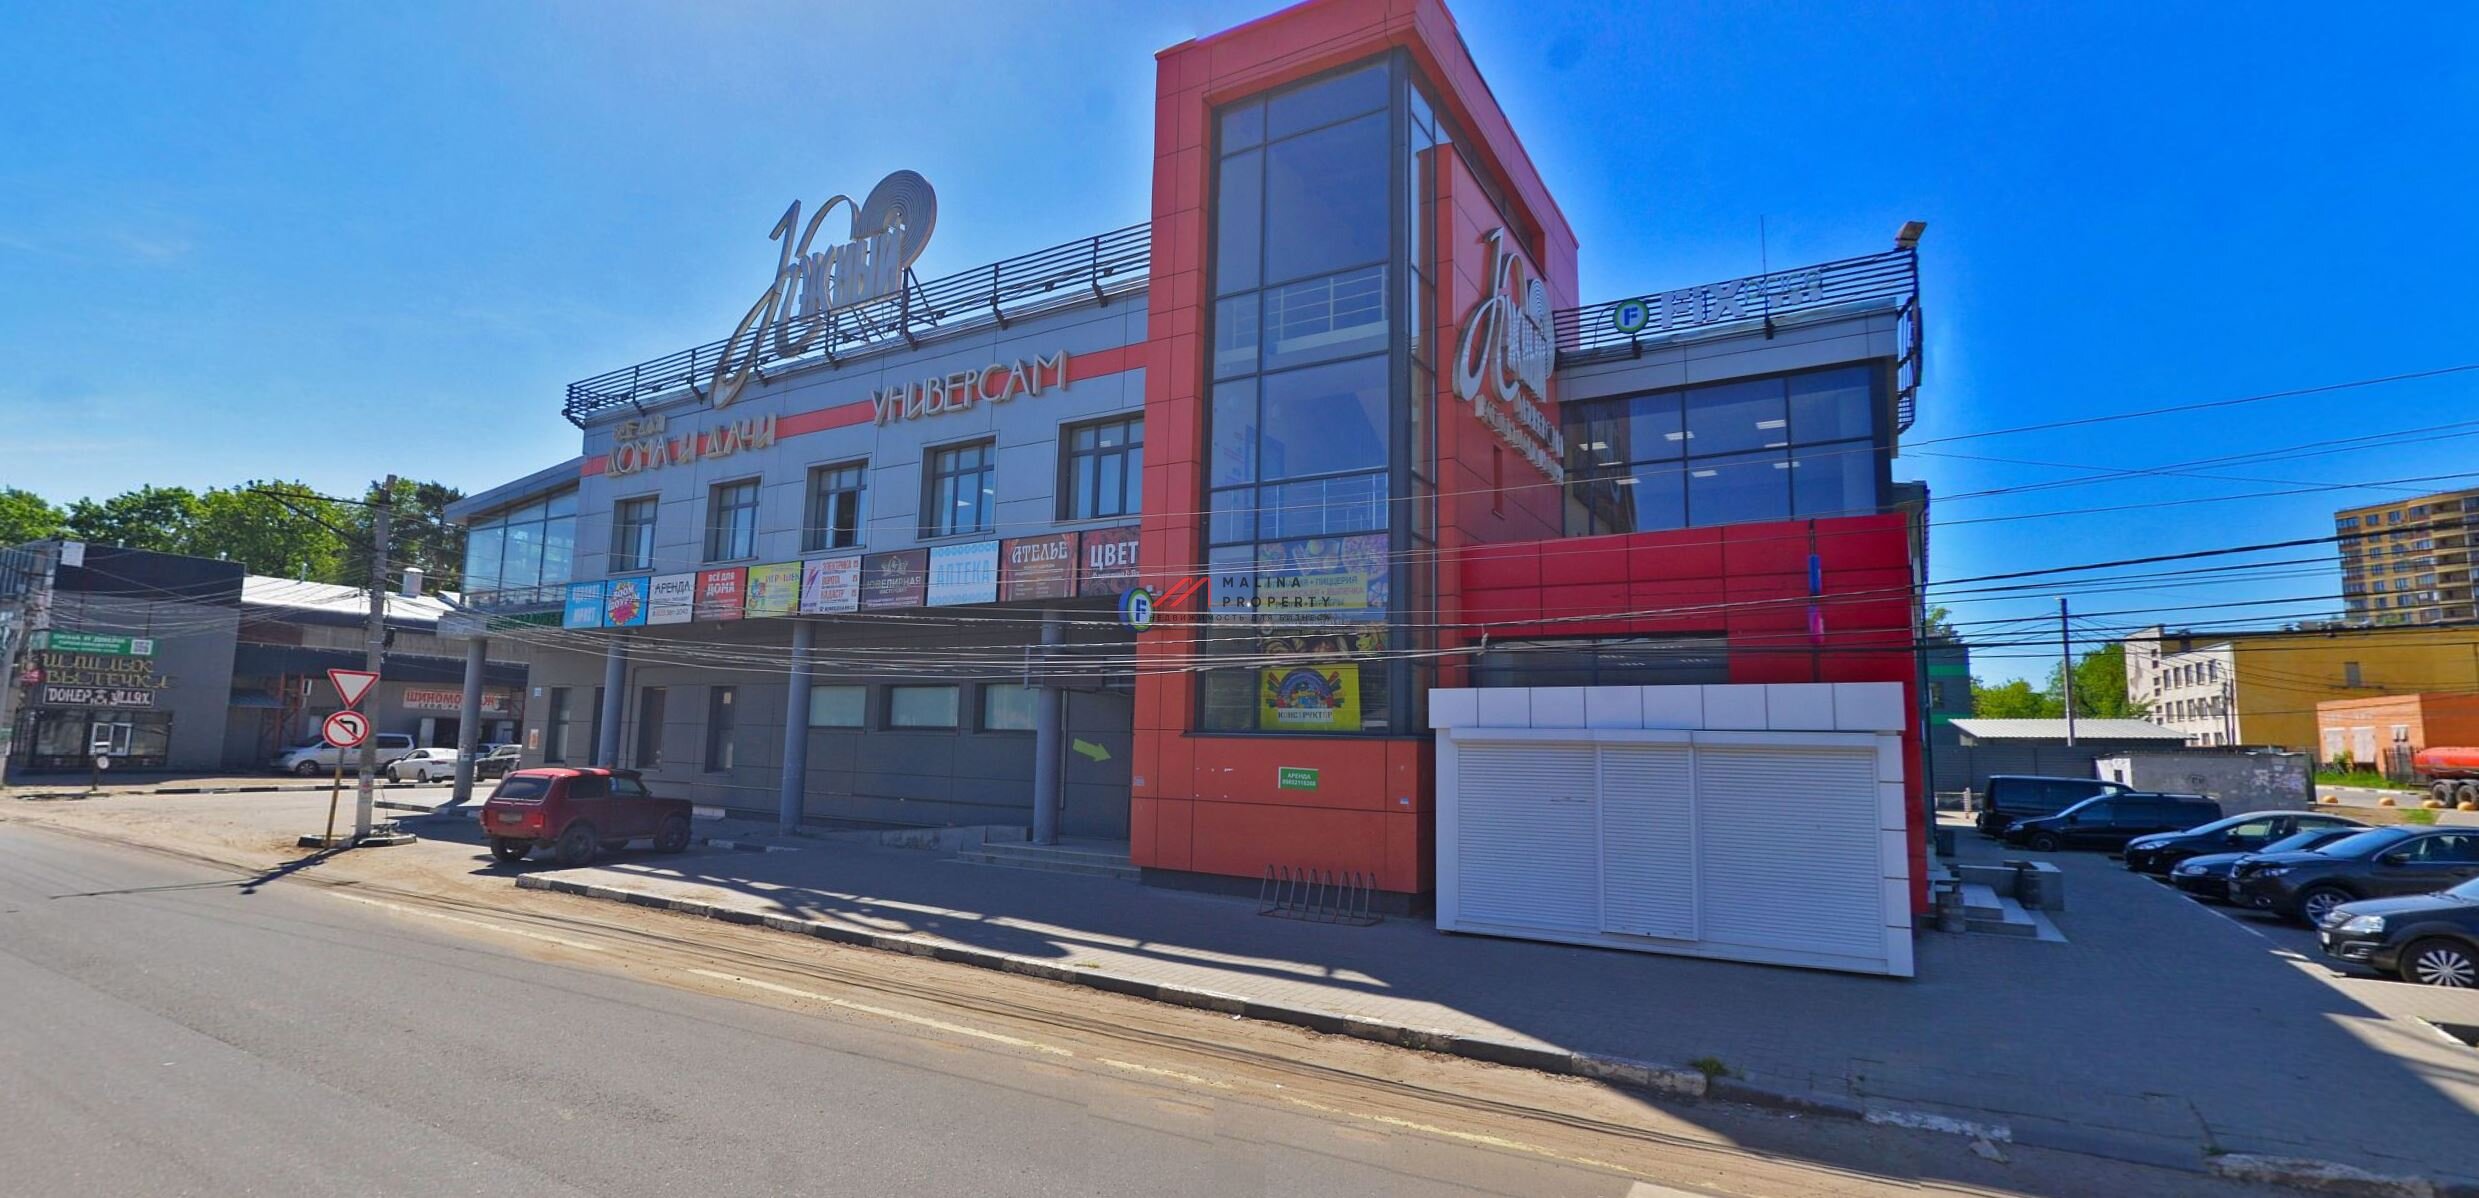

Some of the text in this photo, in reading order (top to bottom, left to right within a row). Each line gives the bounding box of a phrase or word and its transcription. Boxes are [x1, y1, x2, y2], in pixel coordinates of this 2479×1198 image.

[871, 349, 1068, 427] УНИВЕРСАМ
[605, 435, 672, 477] ДОМА
[705, 412, 777, 459] ДАЧИ
[1011, 541, 1068, 564] АТЕЛЬЕ
[1090, 541, 1139, 570] ЦВЕТ
[936, 560, 990, 586] АПТЕКА
[654, 580, 691, 595] АРЕНДА
[706, 581, 735, 596] ДОМА
[48, 687, 93, 703] ДОНЕР
